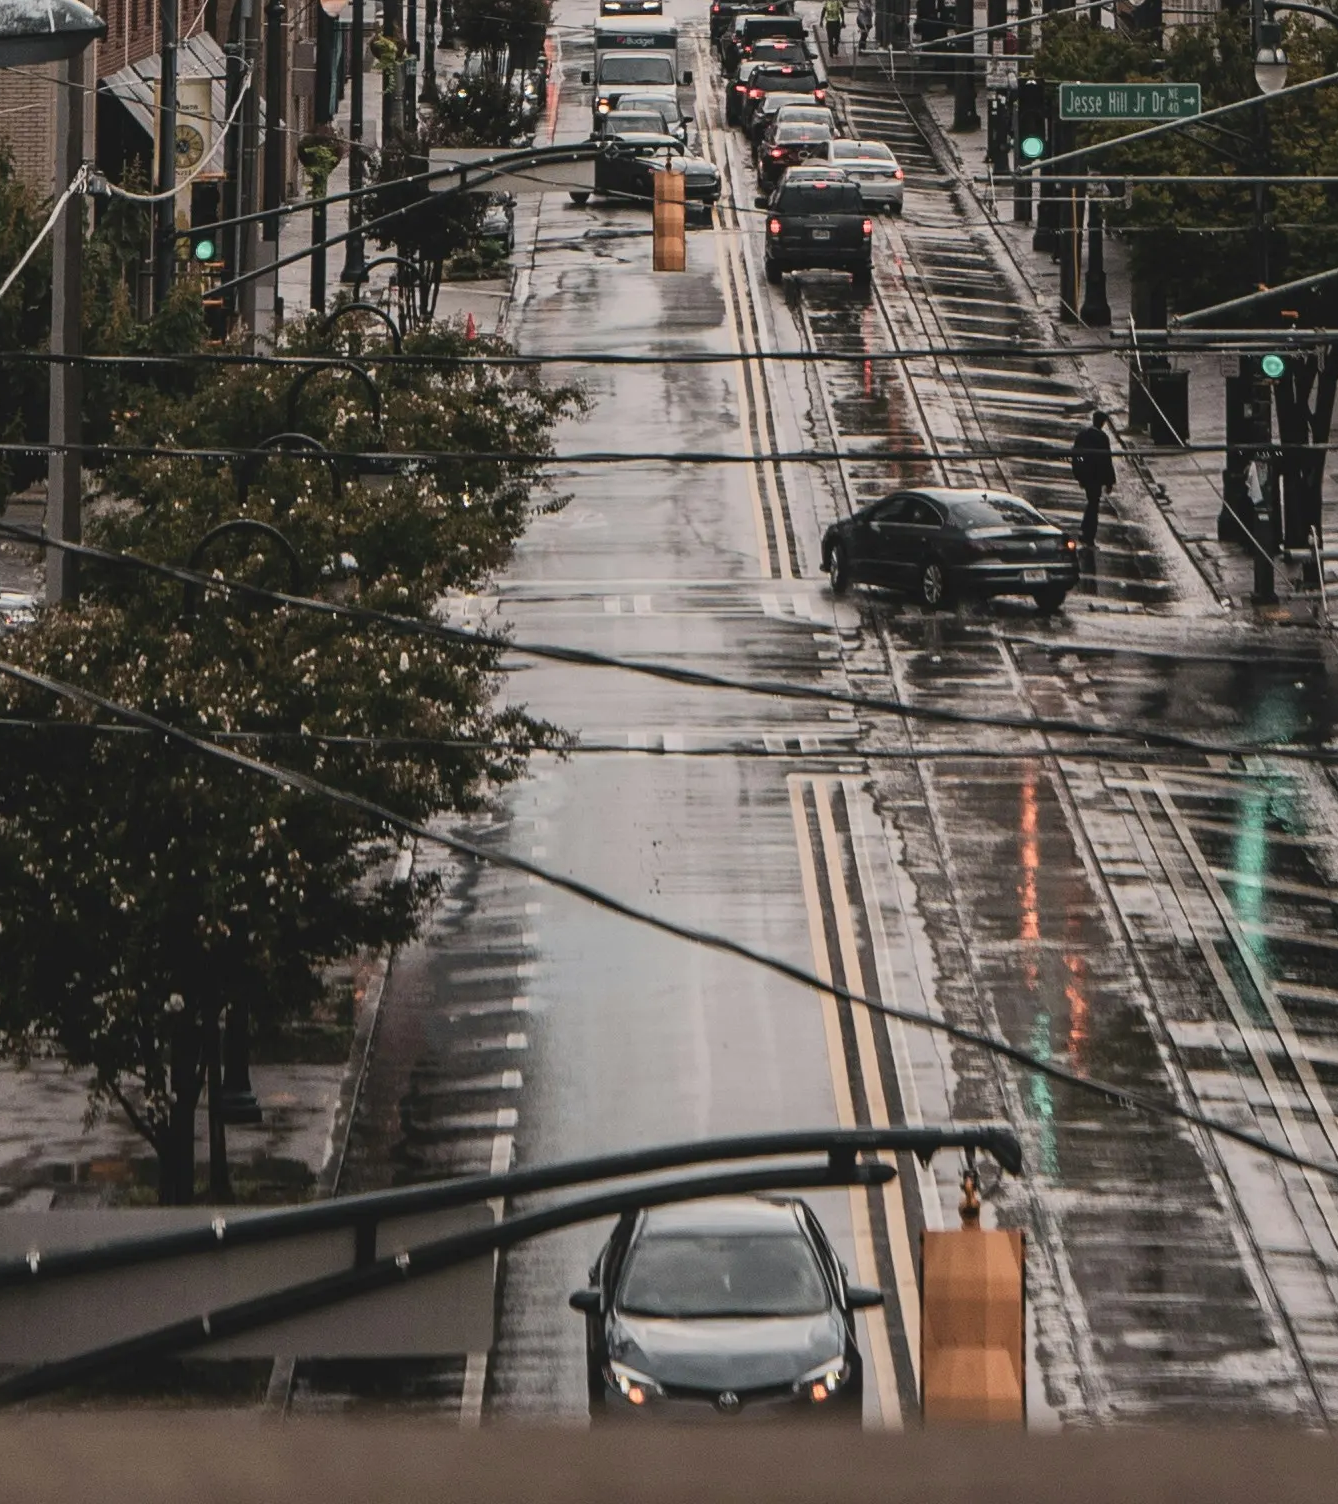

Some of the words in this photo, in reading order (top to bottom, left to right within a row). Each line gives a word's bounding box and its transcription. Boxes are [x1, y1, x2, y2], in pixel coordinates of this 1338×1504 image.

[626, 36, 655, 48] Budget
[1066, 91, 1102, 114] Jesse
[1108, 91, 1128, 113] Hill
[1133, 92, 1147, 113] Jr
[1152, 91, 1166, 113] Dr
[1168, 88, 1179, 100] NE
